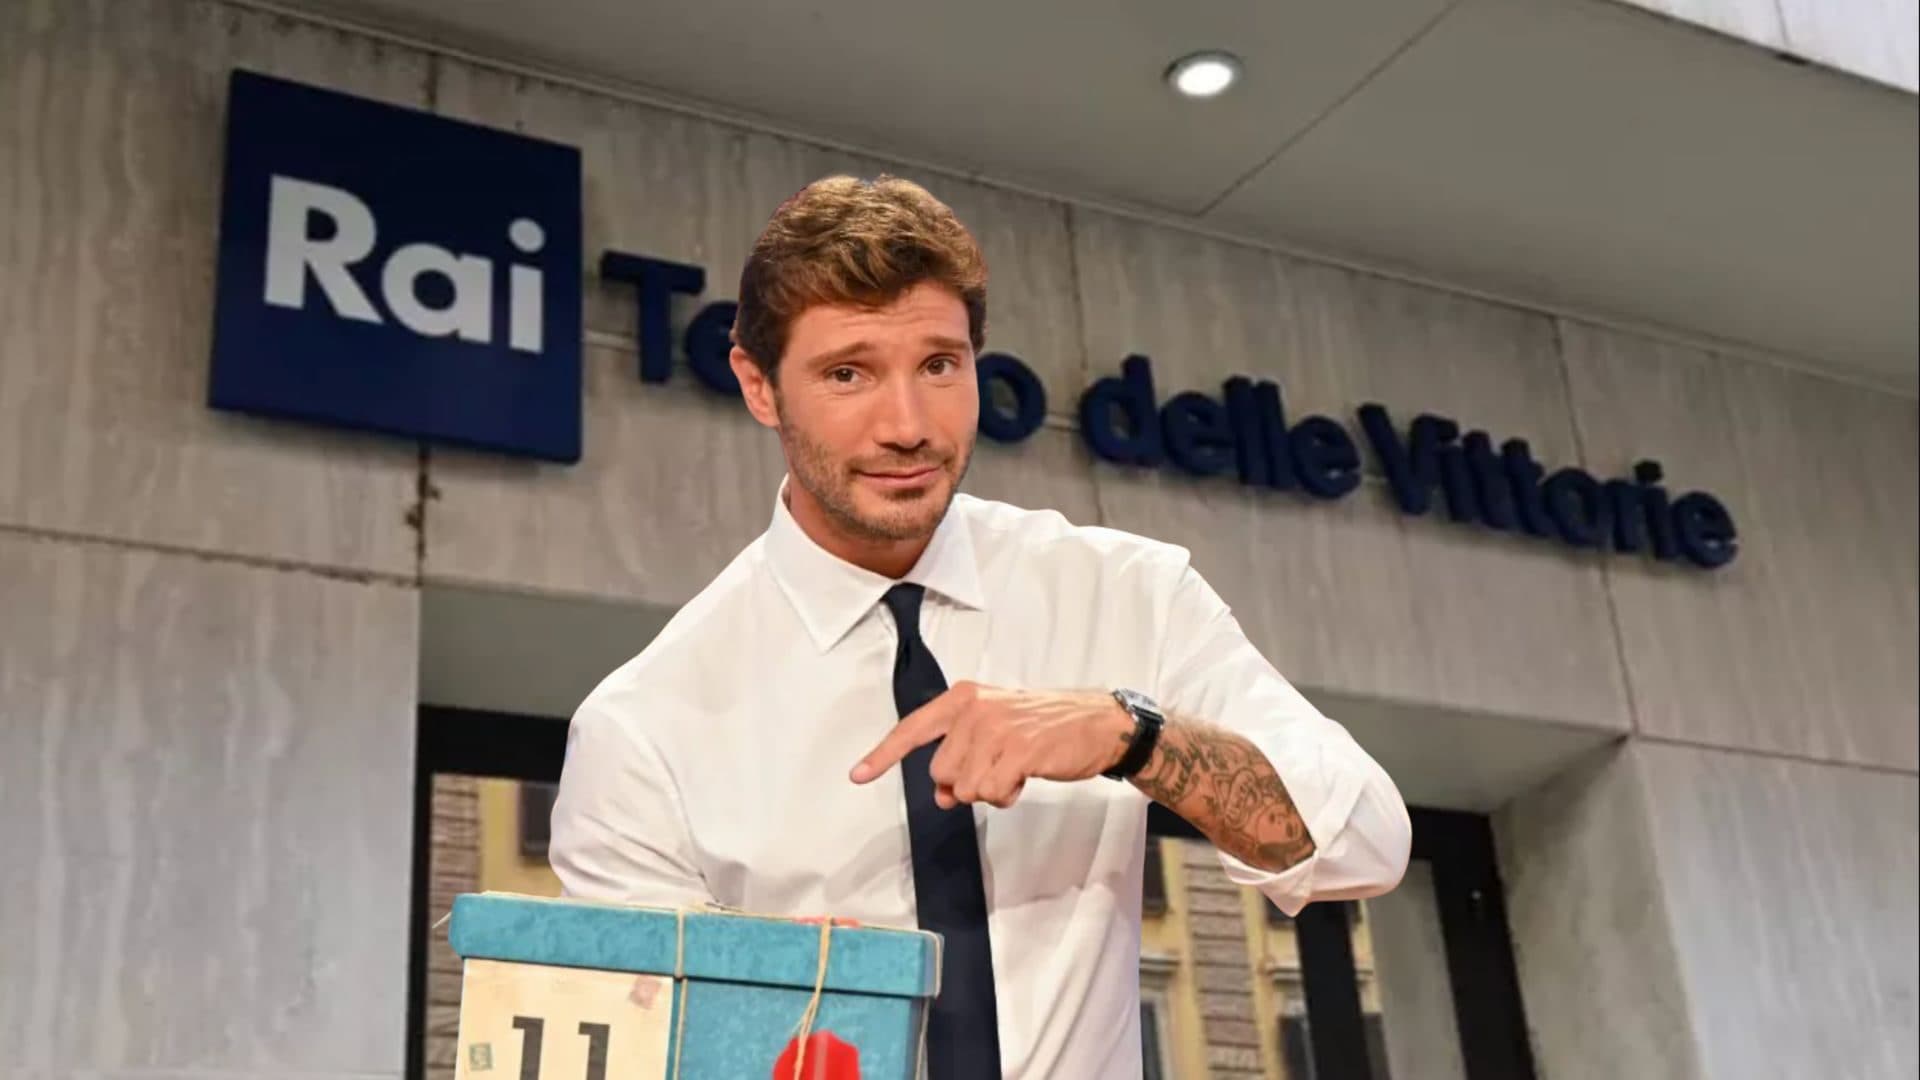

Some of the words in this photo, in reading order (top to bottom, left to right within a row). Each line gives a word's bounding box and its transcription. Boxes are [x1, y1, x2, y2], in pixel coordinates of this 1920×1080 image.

[264, 174, 545, 353] Rai
[599, 250, 1047, 442] Teo
[1080, 353, 1362, 500] delle
[1356, 402, 1738, 568] Vittorie
[512, 1015, 610, 1080] 11
